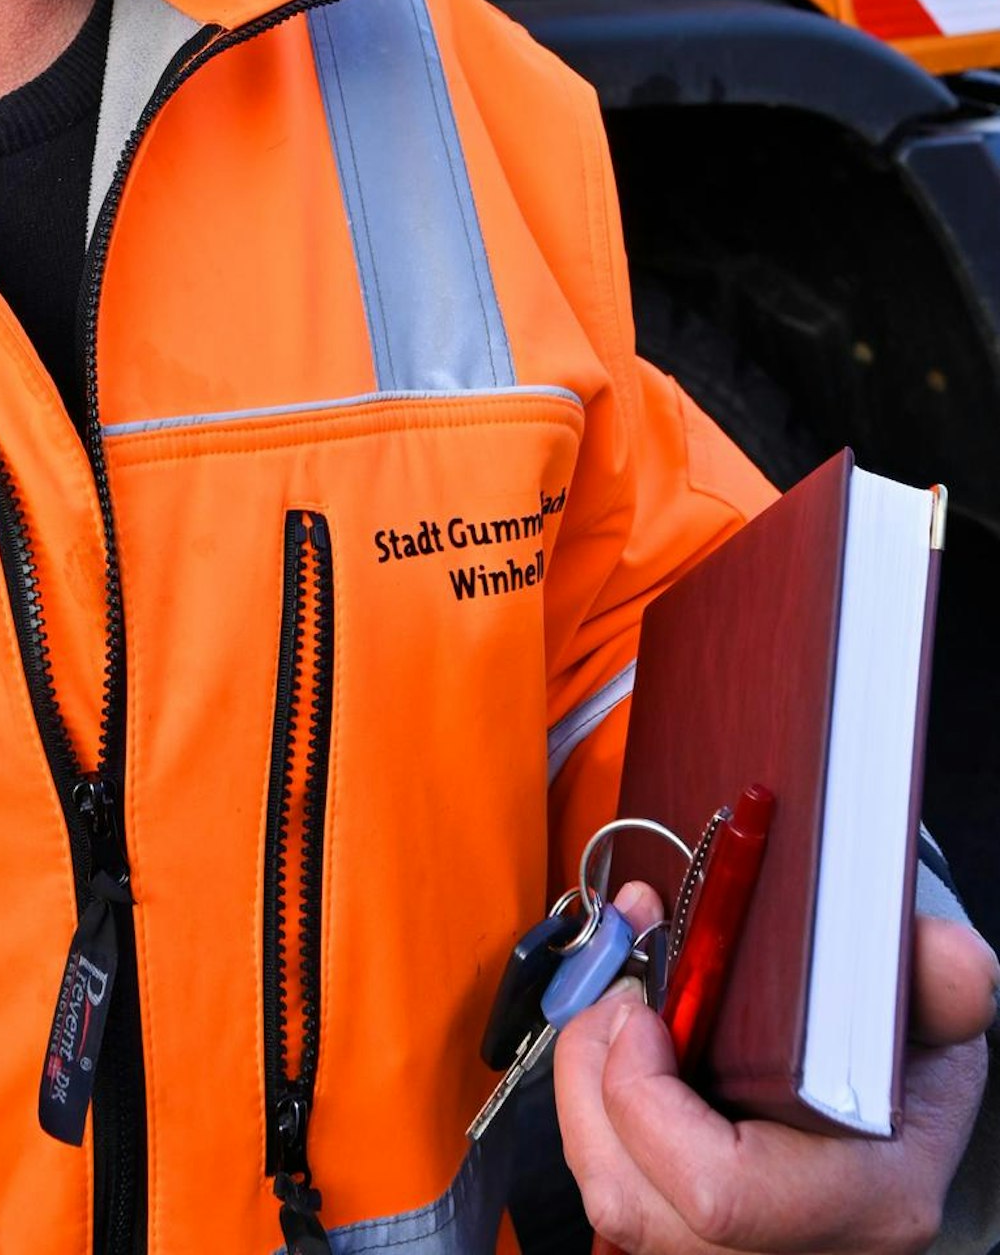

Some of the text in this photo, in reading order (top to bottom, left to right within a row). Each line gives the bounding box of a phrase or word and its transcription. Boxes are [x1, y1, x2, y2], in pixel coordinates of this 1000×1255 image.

[374, 521, 444, 563] Stadt
[51, 955, 108, 1104] Prevent DK
